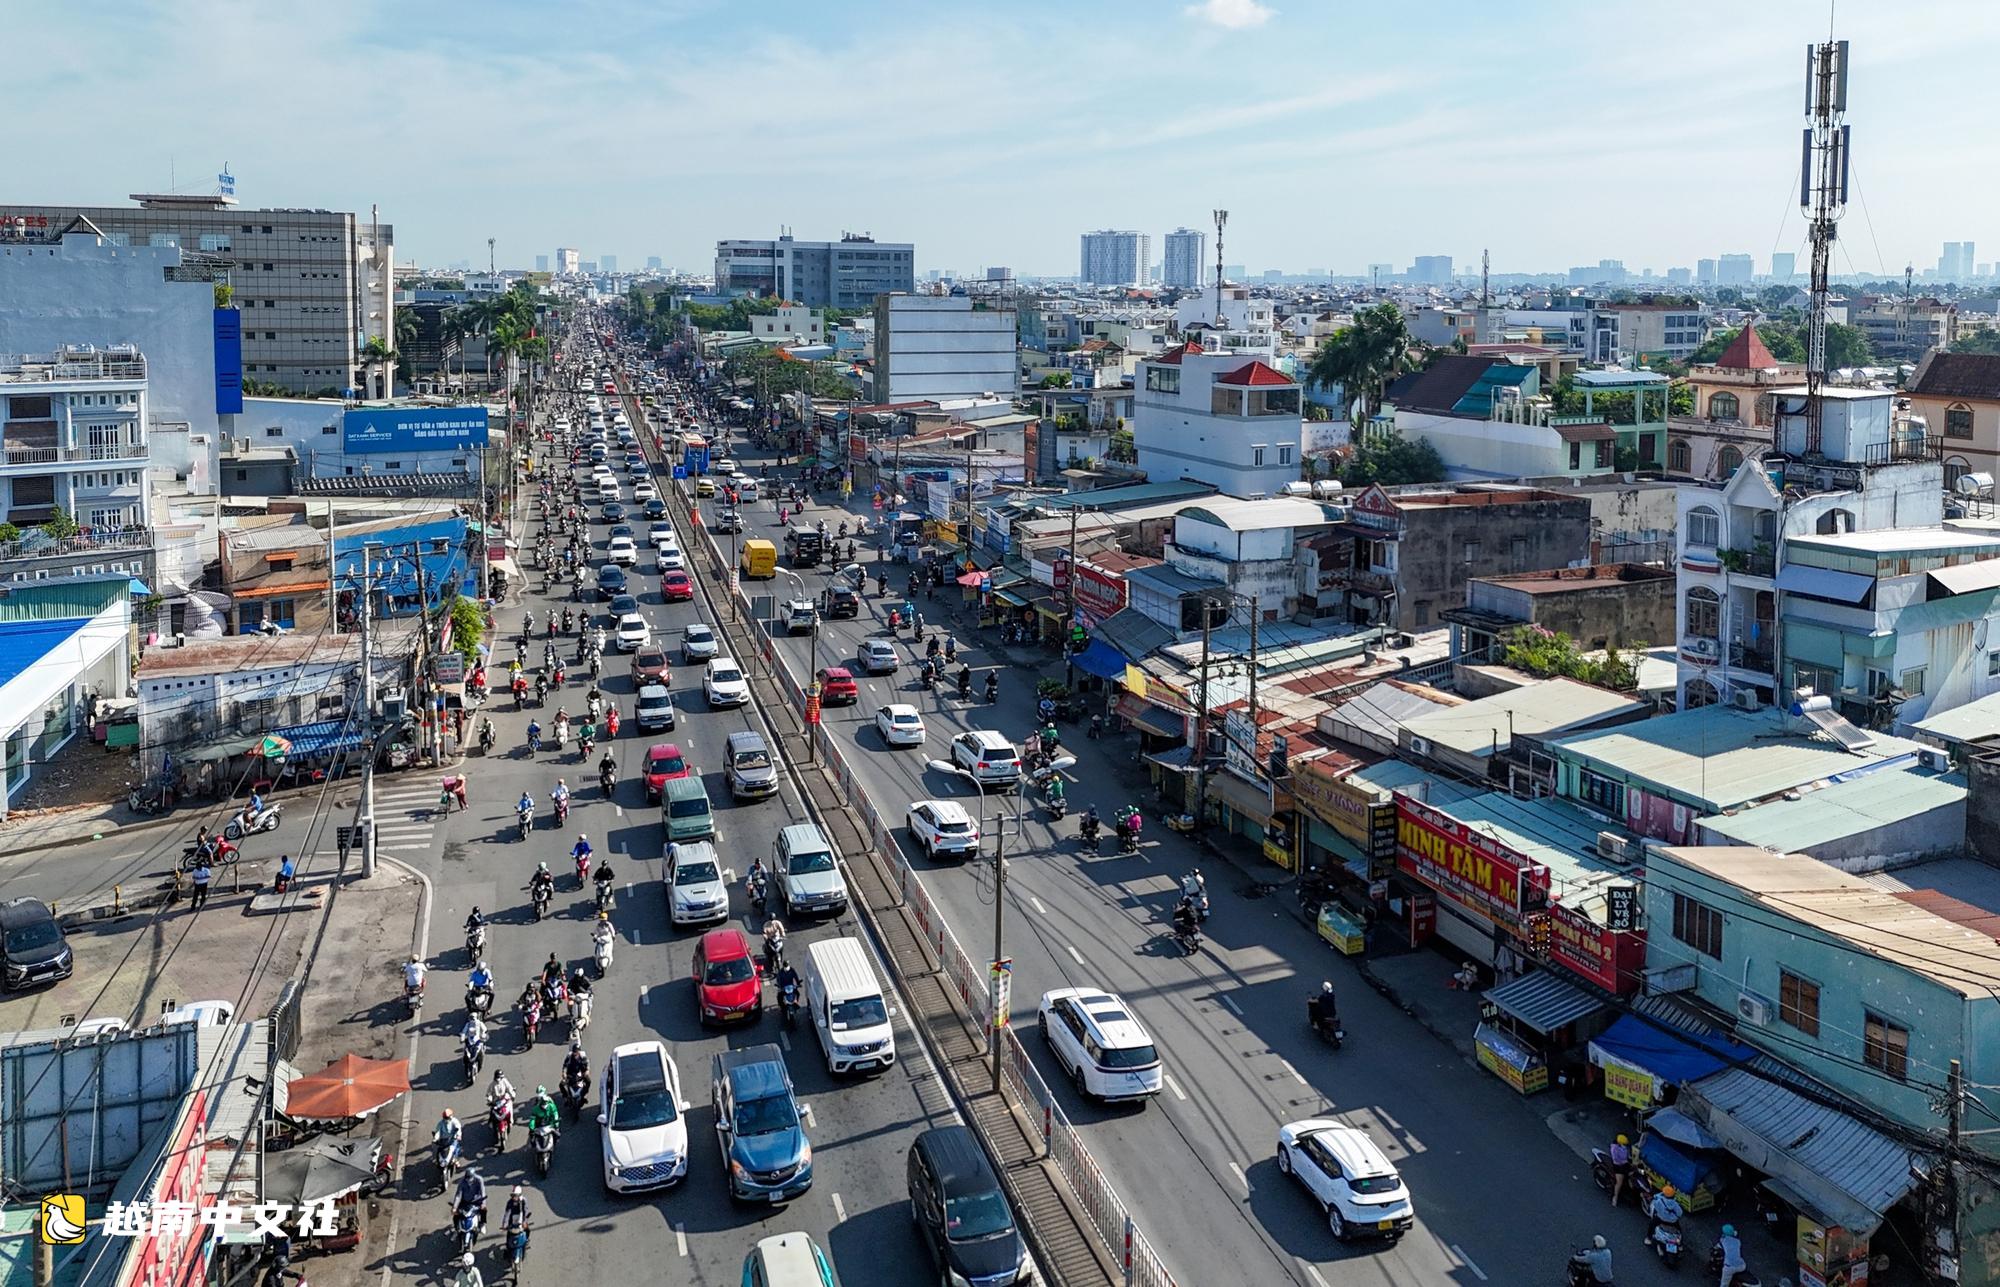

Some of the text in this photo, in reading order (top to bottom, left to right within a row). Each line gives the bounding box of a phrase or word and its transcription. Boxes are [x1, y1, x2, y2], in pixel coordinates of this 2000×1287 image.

[1398, 817, 1446, 865] MINH
[1450, 844, 1492, 890] TÂM
[1612, 891, 1632, 900] ĐẠI
[1614, 900, 1630, 908] LÝ
[1614, 918, 1629, 927] SỐ
[1603, 946, 1611, 960] 2
